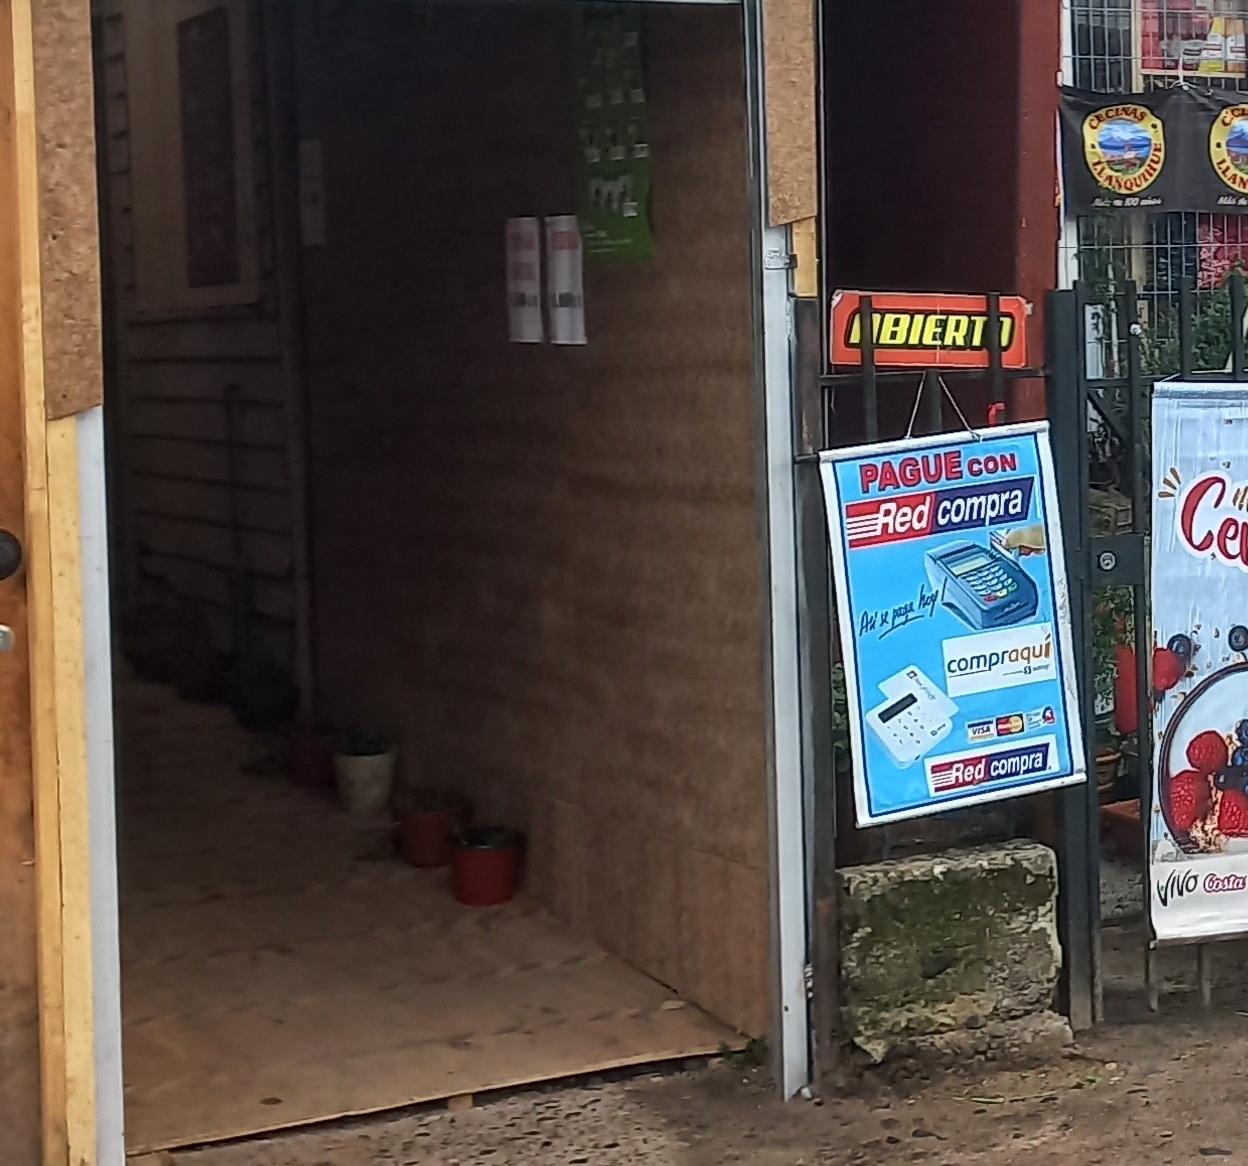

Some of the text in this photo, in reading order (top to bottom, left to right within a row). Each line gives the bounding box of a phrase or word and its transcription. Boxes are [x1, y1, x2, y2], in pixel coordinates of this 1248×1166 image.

[1089, 106, 1147, 130] CECINAS
[1092, 142, 1163, 191] LLANQUIHUE
[859, 450, 1017, 494] PAGUE CON
[877, 488, 1022, 536] Red compra
[947, 633, 1051, 672] compraquí
[971, 725, 991, 736] VISA
[951, 752, 1043, 784] Red compra
[1204, 874, 1247, 892] Costa
